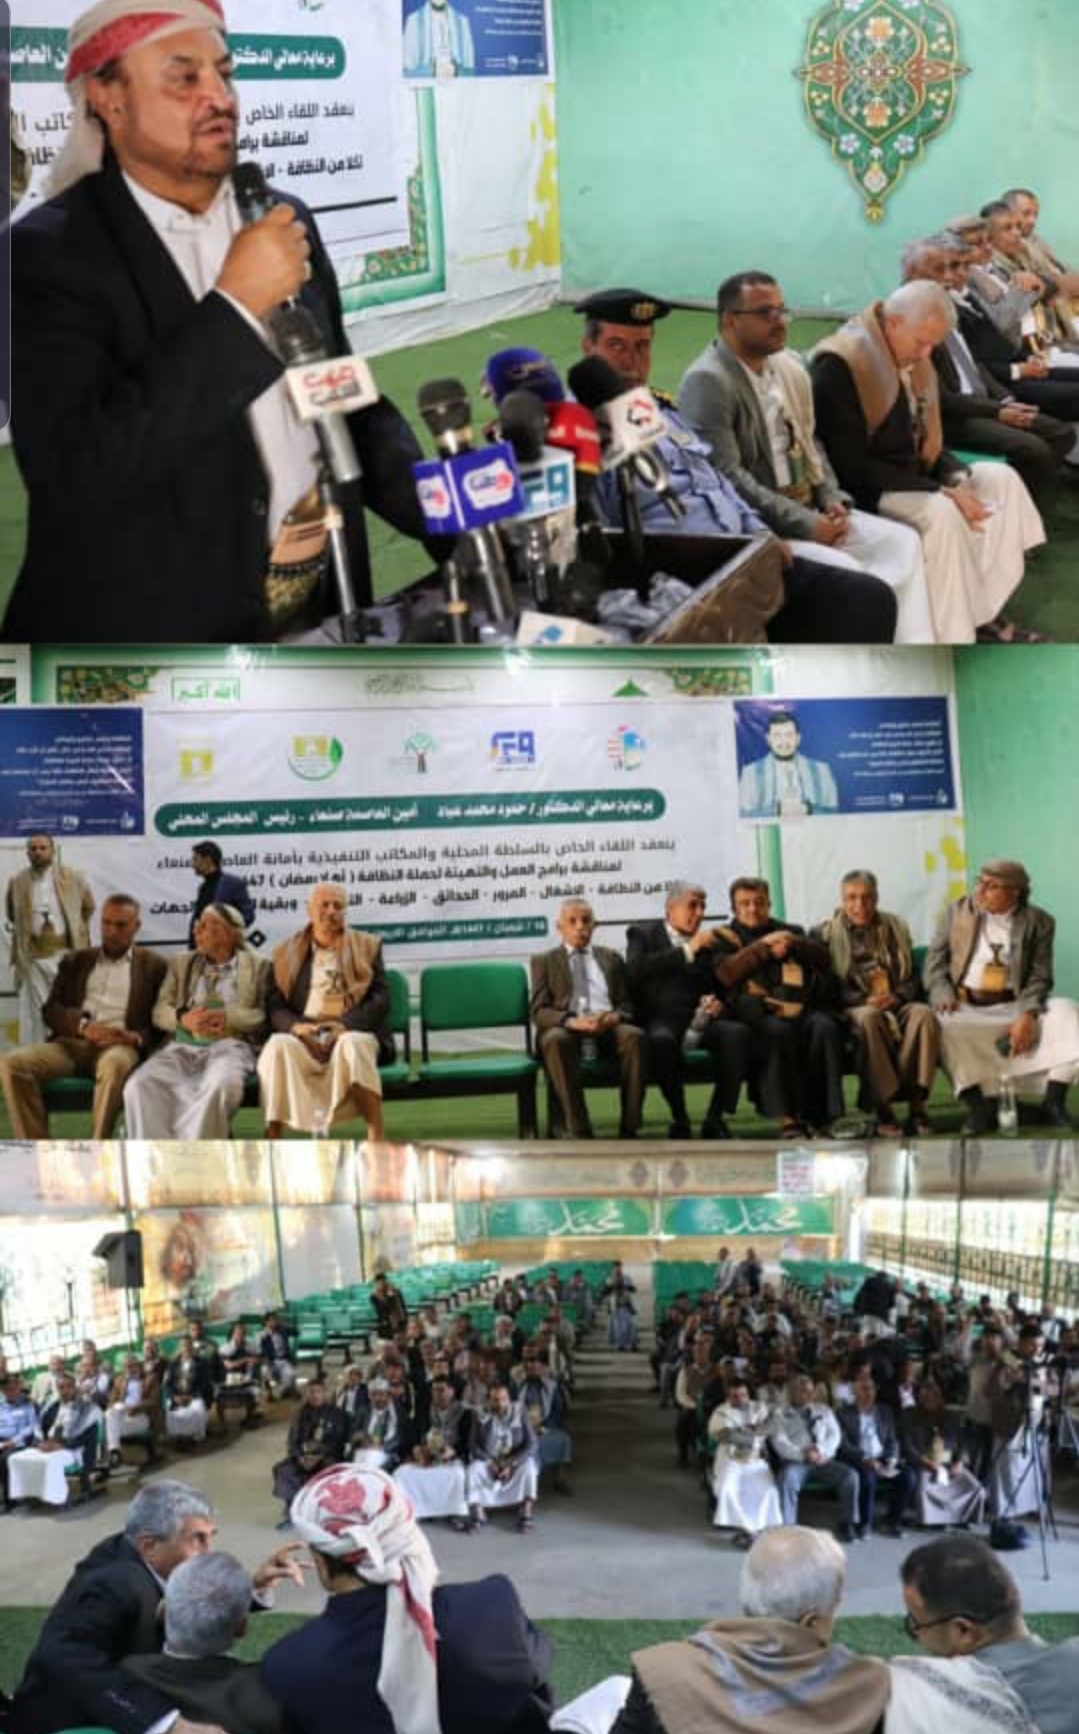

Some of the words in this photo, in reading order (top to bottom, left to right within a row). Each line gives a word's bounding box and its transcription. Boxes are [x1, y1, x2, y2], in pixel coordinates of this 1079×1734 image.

[231, 45, 272, 67] الدكتو
[246, 102, 285, 126] الخاص
[288, 101, 319, 119] اللقاء
[235, 133, 259, 154] برام
[262, 130, 309, 149] لمناقشة
[287, 157, 326, 177] النظافة
[556, 839, 596, 857] الخاص
[221, 851, 258, 868] العاص
[571, 859, 622, 875] لمناقشة
